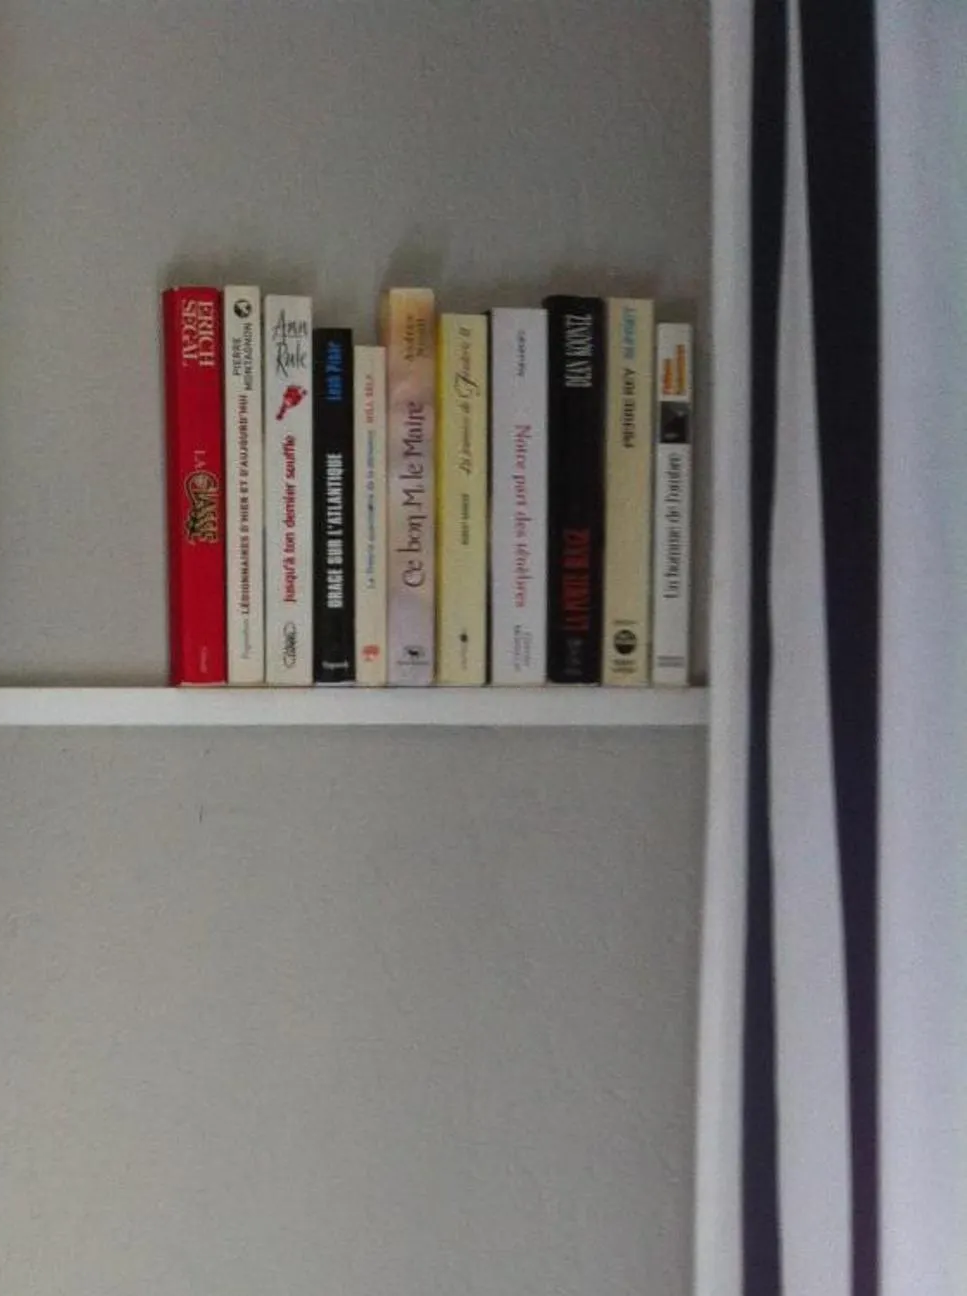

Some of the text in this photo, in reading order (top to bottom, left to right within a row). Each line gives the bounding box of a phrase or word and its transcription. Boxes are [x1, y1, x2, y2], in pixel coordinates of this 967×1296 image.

[181, 300, 198, 367] SEGAL
[198, 301, 215, 367] ERICH
[565, 313, 594, 388] DEAN KOONTZ
[231, 338, 242, 377] PIERRE
[242, 322, 254, 392] MONTAGNON
[402, 400, 424, 458] Maire
[619, 368, 636, 449] PIERRE REY
[194, 451, 207, 472] LA
[281, 436, 297, 480] souffle
[514, 424, 532, 469] Notre
[400, 462, 424, 481] le
[511, 474, 532, 508] part
[237, 395, 250, 614] LÉGIONNAIRES D'HIER ET D'AUJOURD'HUI
[281, 484, 297, 528] dernier
[513, 515, 532, 538] des
[664, 506, 681, 523] de
[283, 532, 297, 554] ton
[325, 453, 345, 609] ORAGE SUR L'ATLANTIQUE
[397, 514, 426, 554] bon
[402, 560, 425, 588] Ce
[513, 542, 532, 609] ténèbres
[664, 581, 681, 599] Un
